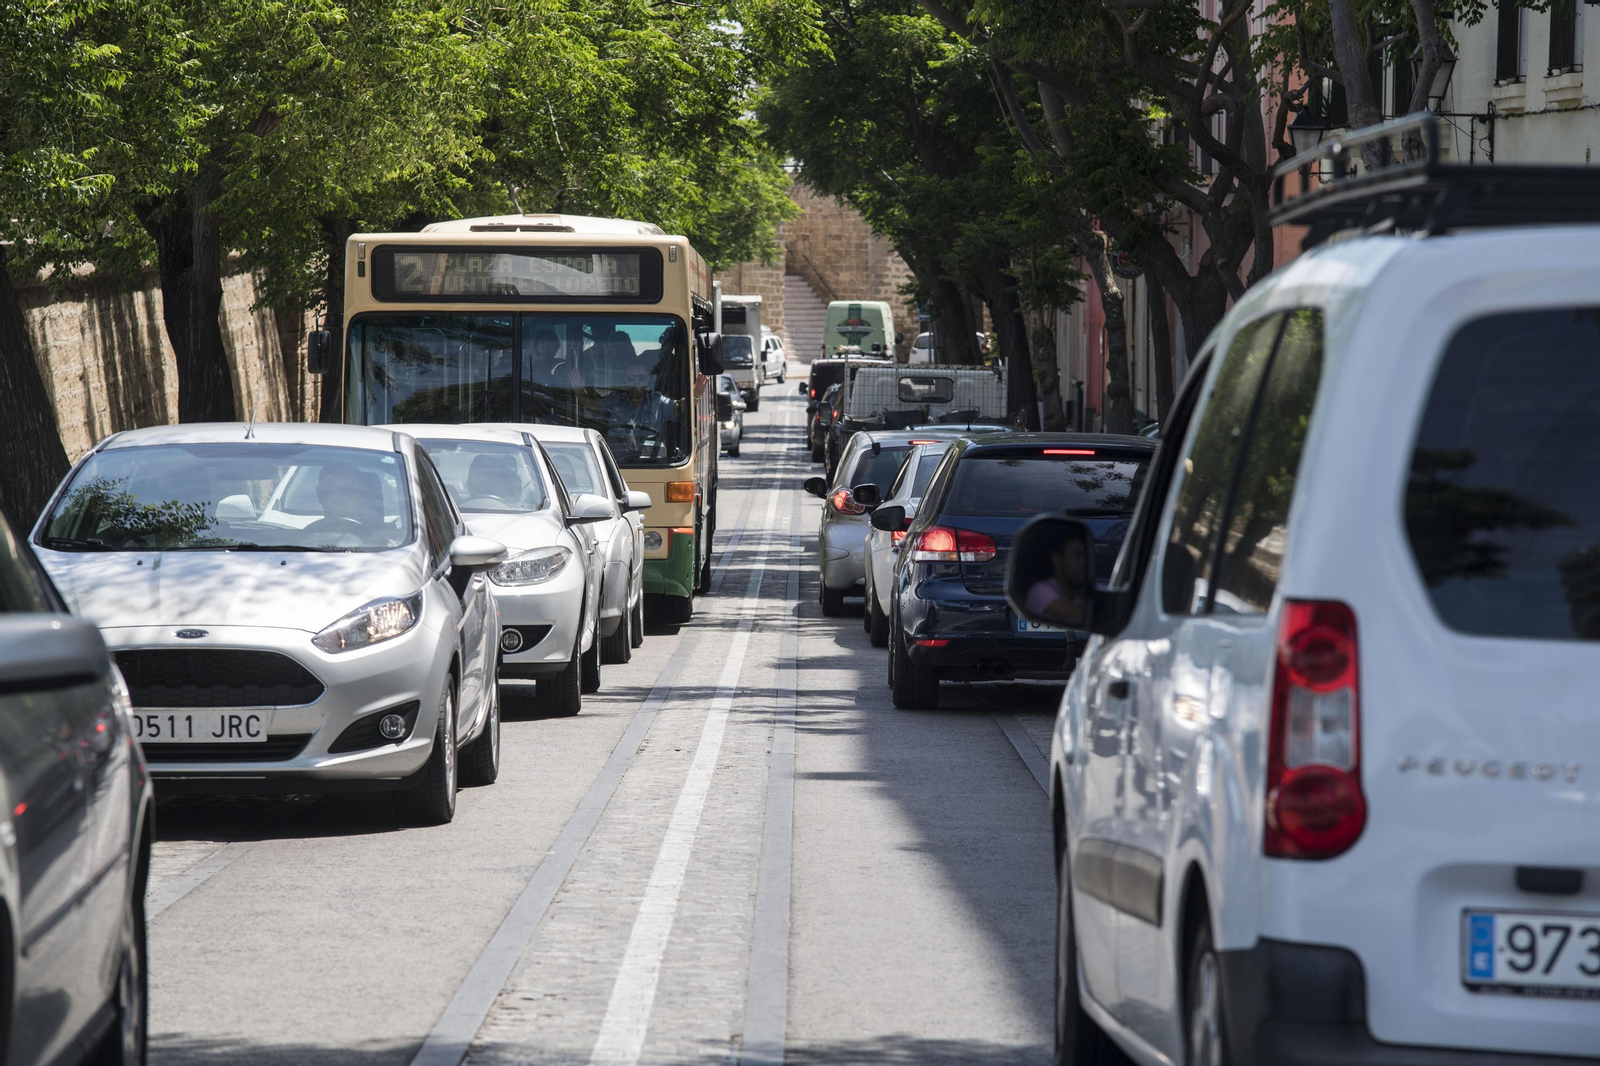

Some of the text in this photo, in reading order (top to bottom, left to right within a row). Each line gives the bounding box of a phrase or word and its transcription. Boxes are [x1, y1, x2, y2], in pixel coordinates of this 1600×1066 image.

[400, 255, 423, 292] 2
[440, 256, 512, 273] PLAZA
[211, 714, 261, 738] JRC
[1398, 756, 1580, 782] PEUGEOT
[1505, 922, 1600, 977] 973
